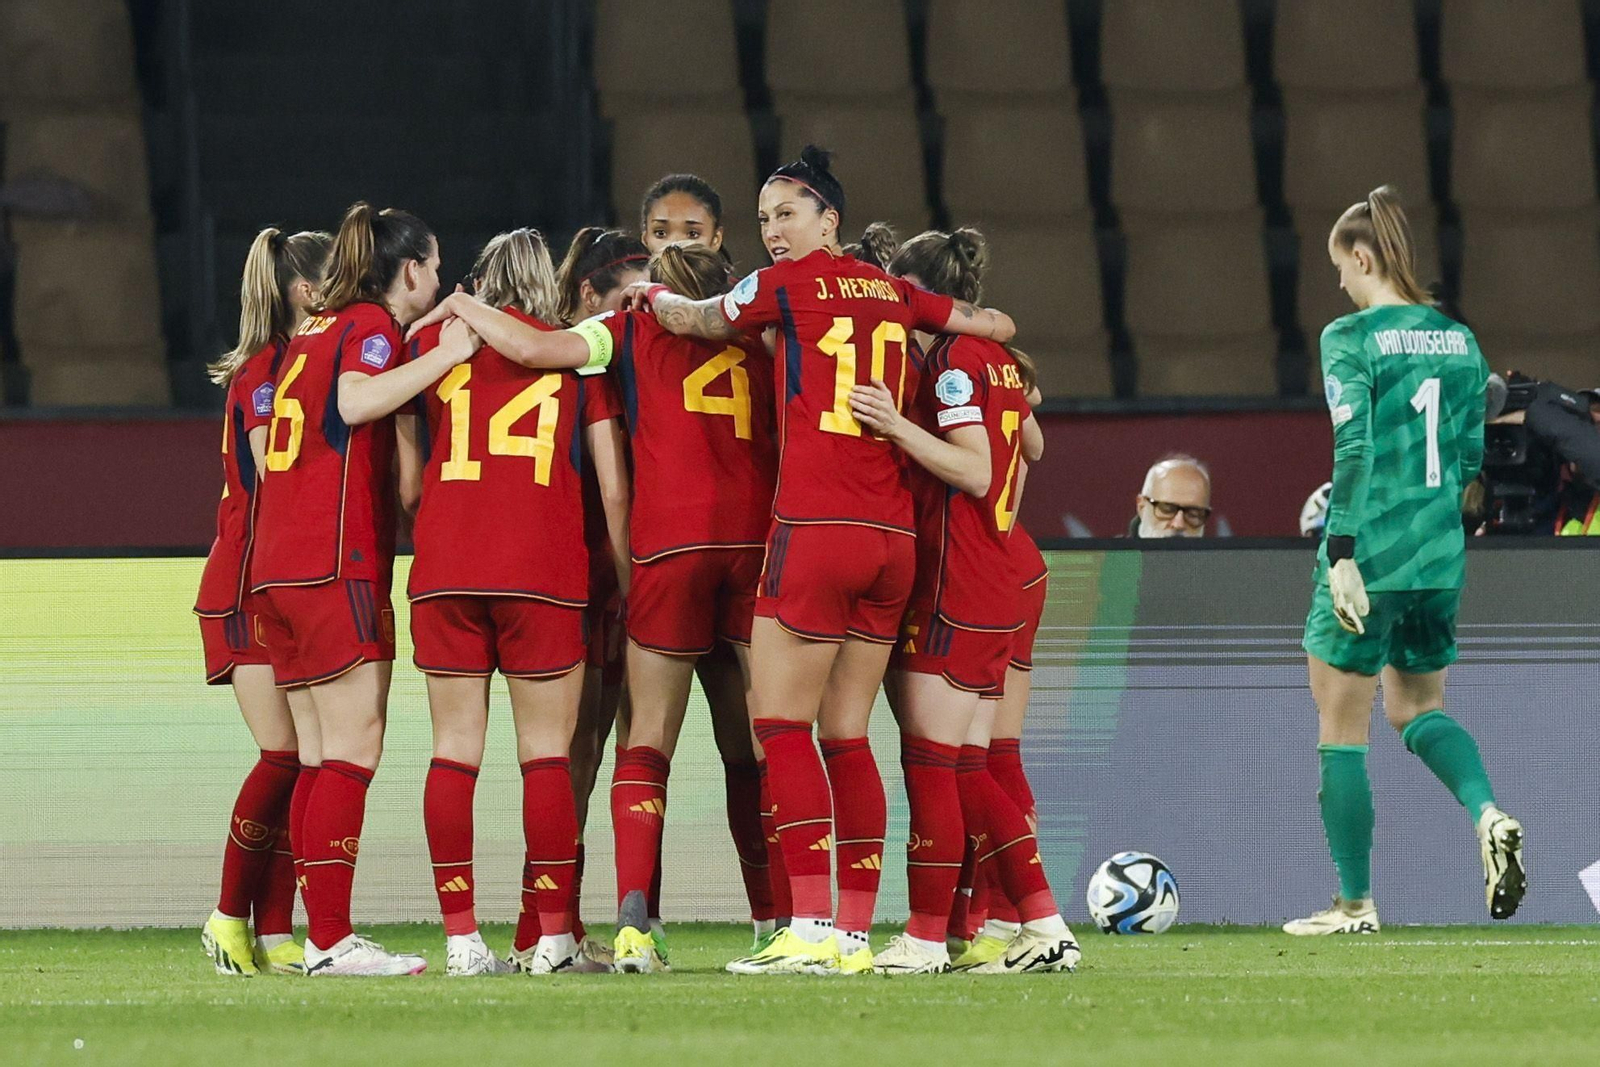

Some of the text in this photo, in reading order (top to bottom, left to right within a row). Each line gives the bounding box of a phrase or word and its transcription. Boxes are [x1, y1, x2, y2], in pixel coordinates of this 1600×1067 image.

[815, 276, 900, 303] J. HERMOSO
[1374, 329, 1469, 356] VAN DOMSELAAR
[265, 353, 308, 472] 6
[436, 363, 562, 487] 14
[683, 345, 752, 441] 4
[817, 317, 907, 441] 10
[1409, 377, 1442, 488] 1
[994, 410, 1020, 531] 2
